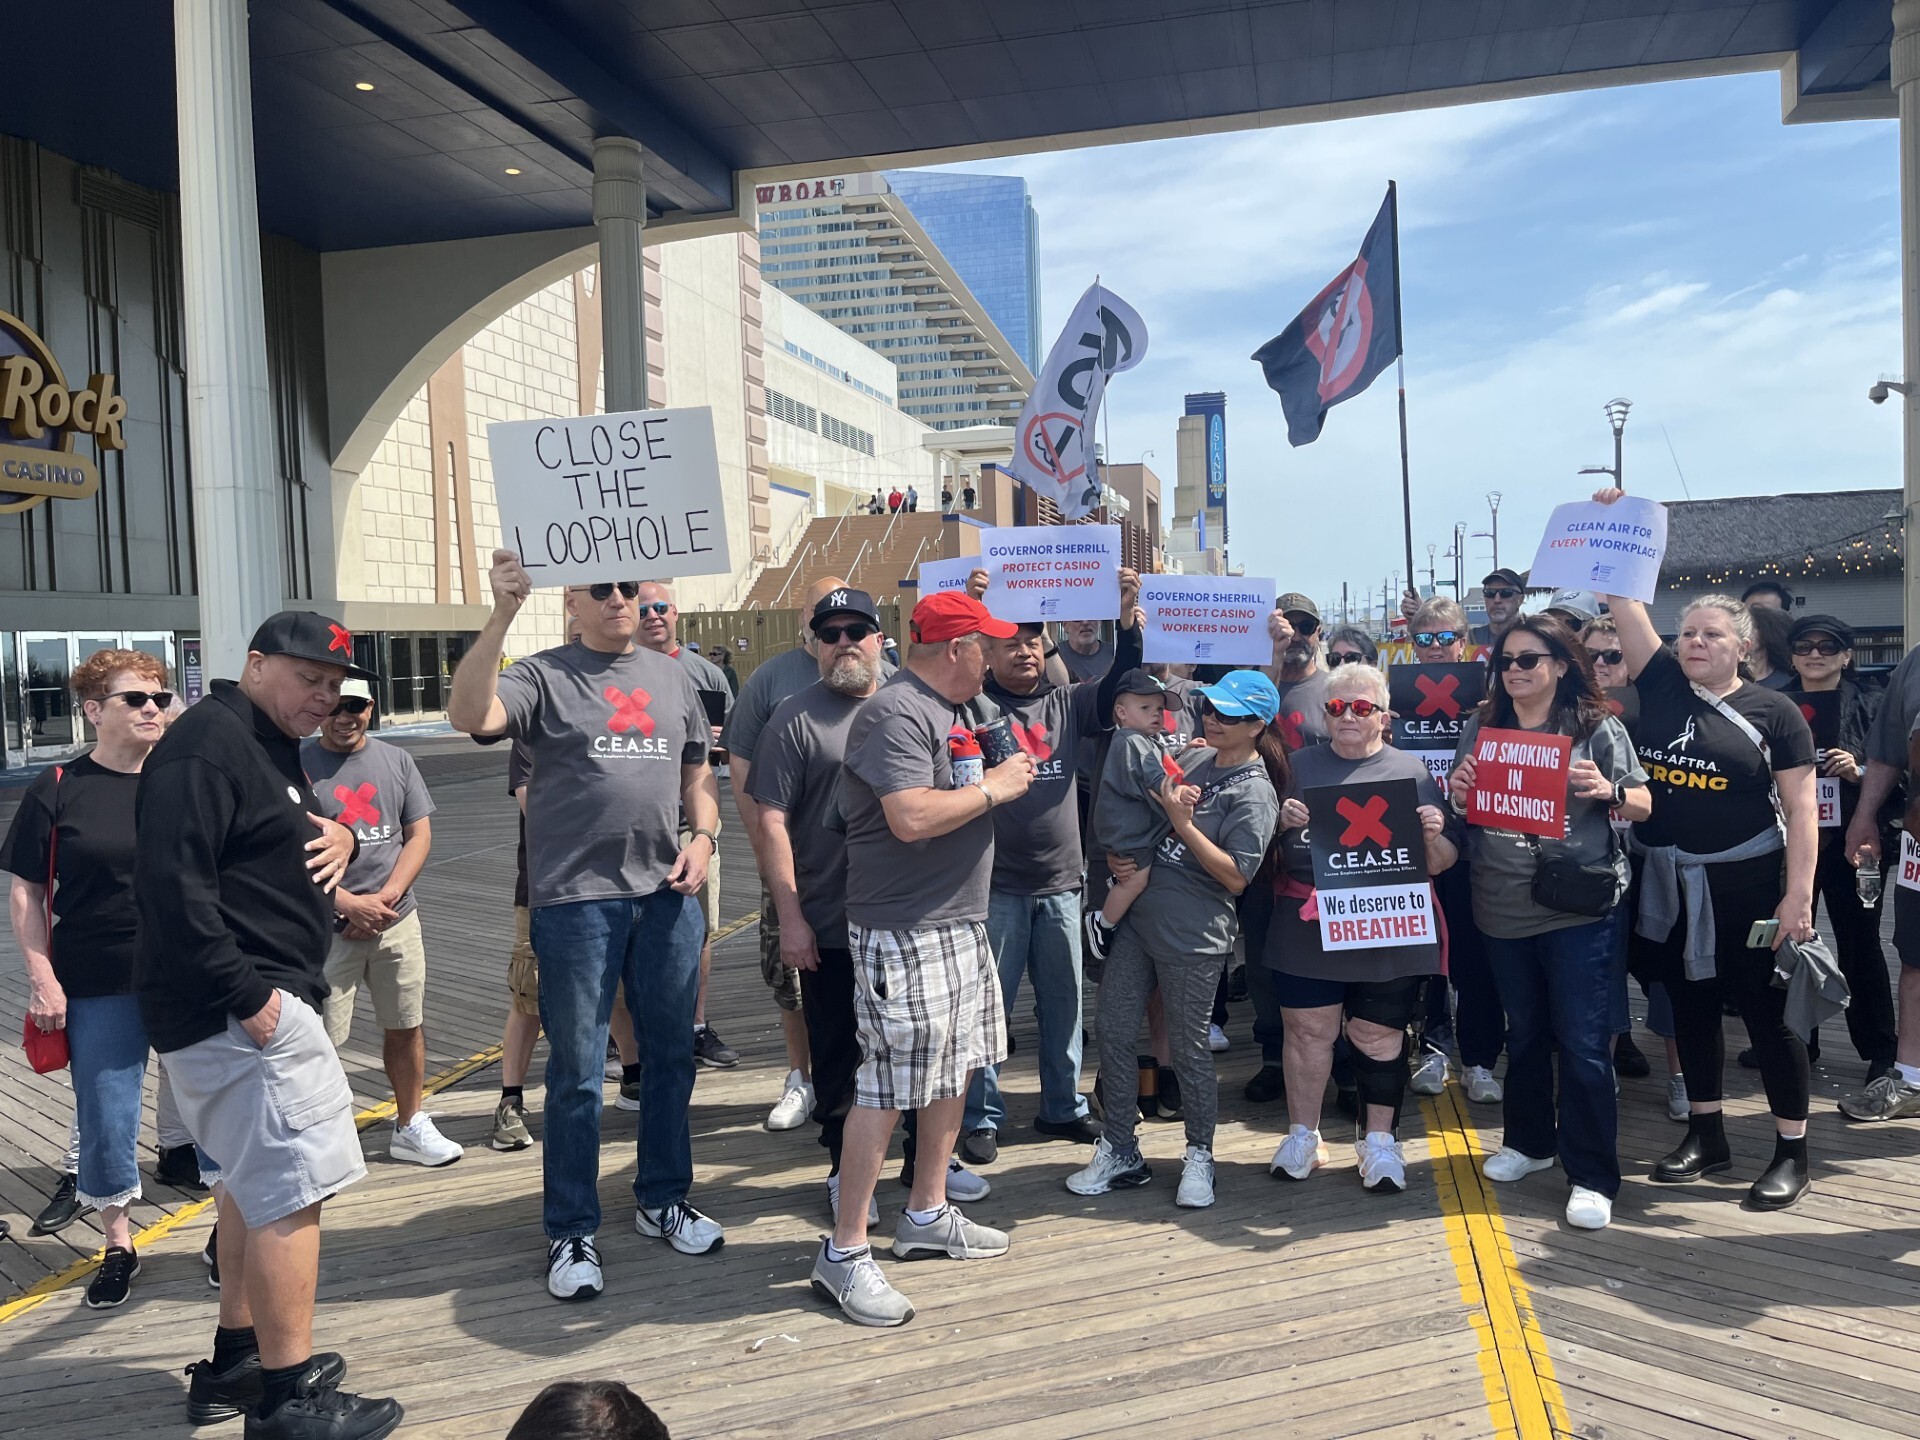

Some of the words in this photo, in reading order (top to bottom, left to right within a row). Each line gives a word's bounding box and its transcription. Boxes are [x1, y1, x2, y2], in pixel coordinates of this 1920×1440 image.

[2, 355, 127, 450] Rock
[535, 418, 672, 470] CLOSE
[1213, 422, 1222, 482] ISLAND
[2, 459, 86, 486] CASINO
[563, 467, 648, 510] THE
[515, 510, 713, 568] LOOPHOLE
[1567, 522, 1606, 532] CLEAN
[1607, 522, 1631, 534] AIR
[1632, 525, 1652, 539] FOR
[989, 545, 1053, 557] GOVERNOR
[1055, 543, 1110, 555] SHERRILL,
[1550, 538, 1587, 548] EVERY
[1589, 538, 1657, 559] WORKPLACE
[1002, 562, 1052, 573] PROTECT
[1054, 560, 1101, 571] CASINO
[939, 578, 967, 588] CLEAN
[1006, 578, 1062, 589] WORKERS
[1065, 577, 1095, 588] NOW
[830, 590, 848, 607] NY
[1146, 591, 1210, 602] GOVERNOR
[1212, 593, 1266, 605] SHERRILL,
[1158, 607, 1209, 617] PROTECT
[1211, 609, 1256, 619] CASINO
[1162, 623, 1217, 633] WORKERS
[1220, 625, 1250, 634] NOW
[594, 736, 668, 753] C.E.A.S.E
[1478, 741, 1498, 762] NO
[1498, 742, 1560, 770] SMOKING
[1508, 769, 1523, 791] IN
[1822, 783, 1833, 799] to
[1476, 790, 1491, 812] NJ
[1493, 793, 1555, 823] CASINOS!
[1328, 847, 1410, 869] C.E.A.S.E
[1324, 895, 1346, 915] We
[1349, 894, 1406, 914] deserve
[1408, 891, 1425, 909] to
[1328, 915, 1428, 943] BREATHE!
